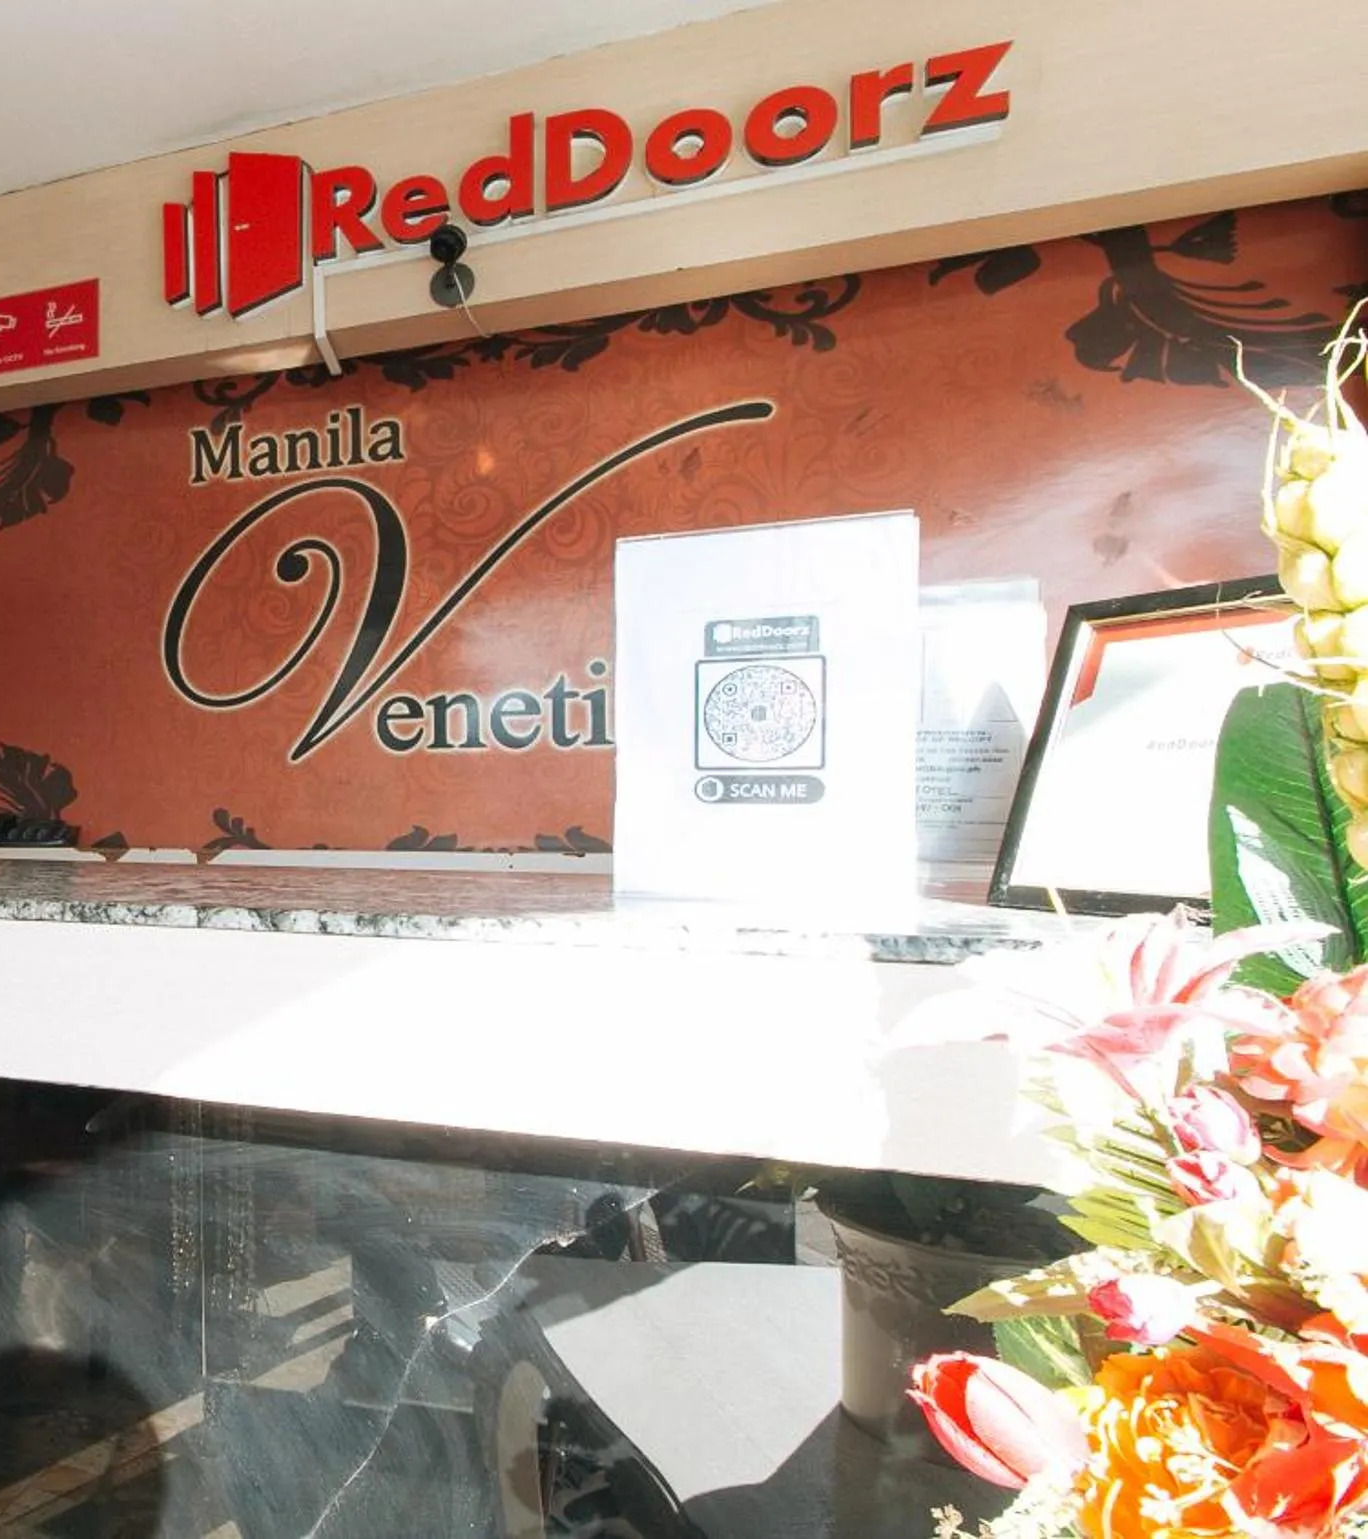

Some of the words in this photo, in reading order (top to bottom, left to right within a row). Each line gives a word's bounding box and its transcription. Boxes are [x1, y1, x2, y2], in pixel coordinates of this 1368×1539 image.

[311, 41, 1013, 264] RedDoorz
[189, 407, 405, 484] Manila
[732, 625, 810, 641] RedDoorz
[730, 782, 776, 798] SCAN
[781, 782, 809, 798] ME
